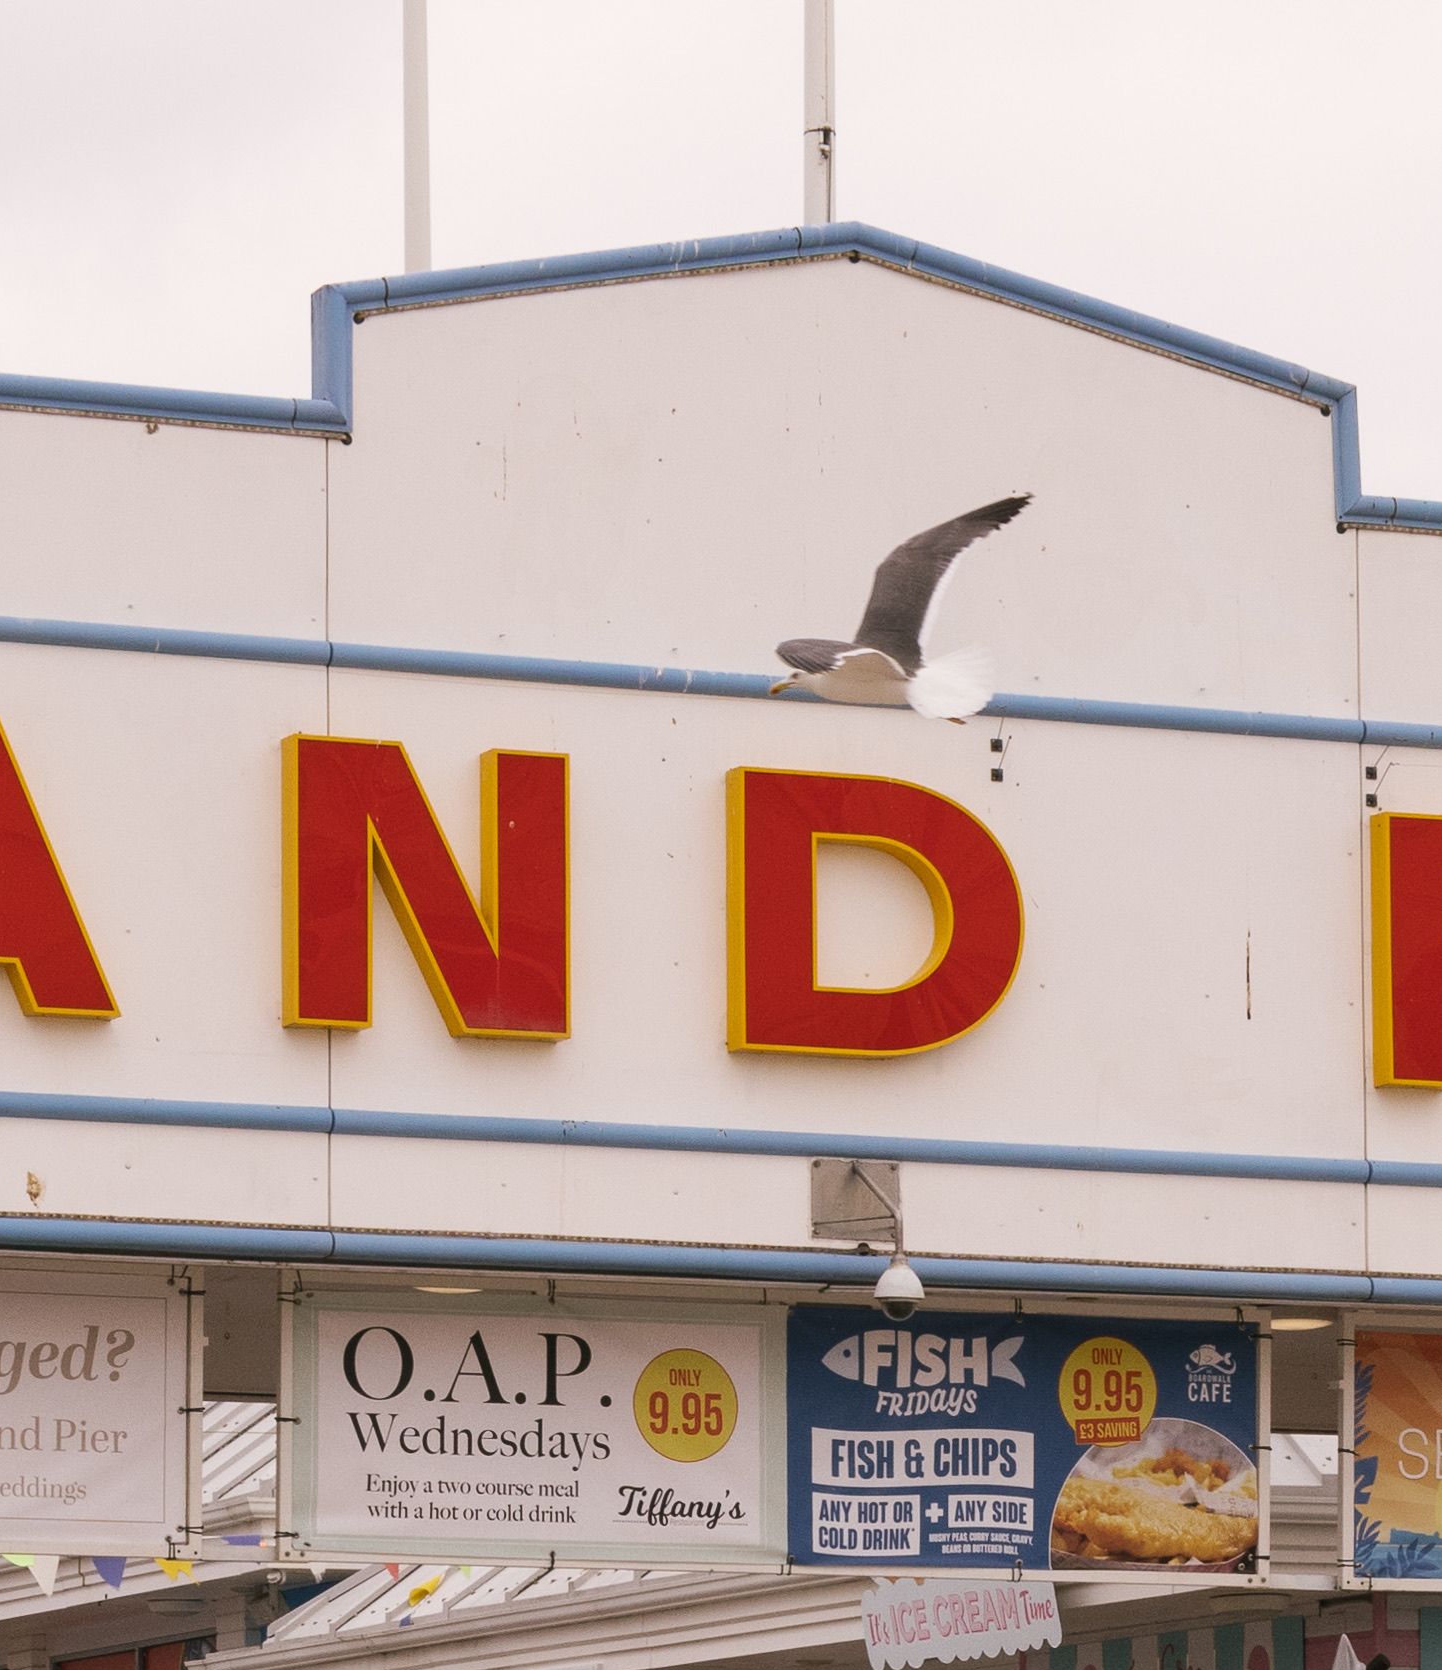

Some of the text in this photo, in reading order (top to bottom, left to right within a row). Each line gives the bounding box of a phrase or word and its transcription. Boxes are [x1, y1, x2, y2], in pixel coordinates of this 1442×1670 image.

[343, 1326, 613, 1408] O.A.P.
[863, 1329, 989, 1388] FISH
[1092, 1347, 1122, 1366] ONLY
[669, 1369, 701, 1387] ONLY
[1072, 1369, 1143, 1412] 9.95
[648, 1391, 723, 1436] 9.95
[1079, 1422, 1138, 1440] £3 SAVING
[53, 1418, 128, 1454] Pier
[346, 1412, 610, 1471] Wednesdays
[831, 1438, 1017, 1480] FISH & CHIPS
[365, 1473, 580, 1498] Enjoy a two course meal
[368, 1502, 576, 1523] with a hot or cold drink
[618, 1485, 746, 1529] Tiffany's
[819, 1500, 913, 1523] ANY HOT OR
[954, 1500, 1027, 1525] ANY SIDE
[818, 1526, 857, 1550] COLD
[866, 1588, 1055, 1646] It's ICE CREAM Time
